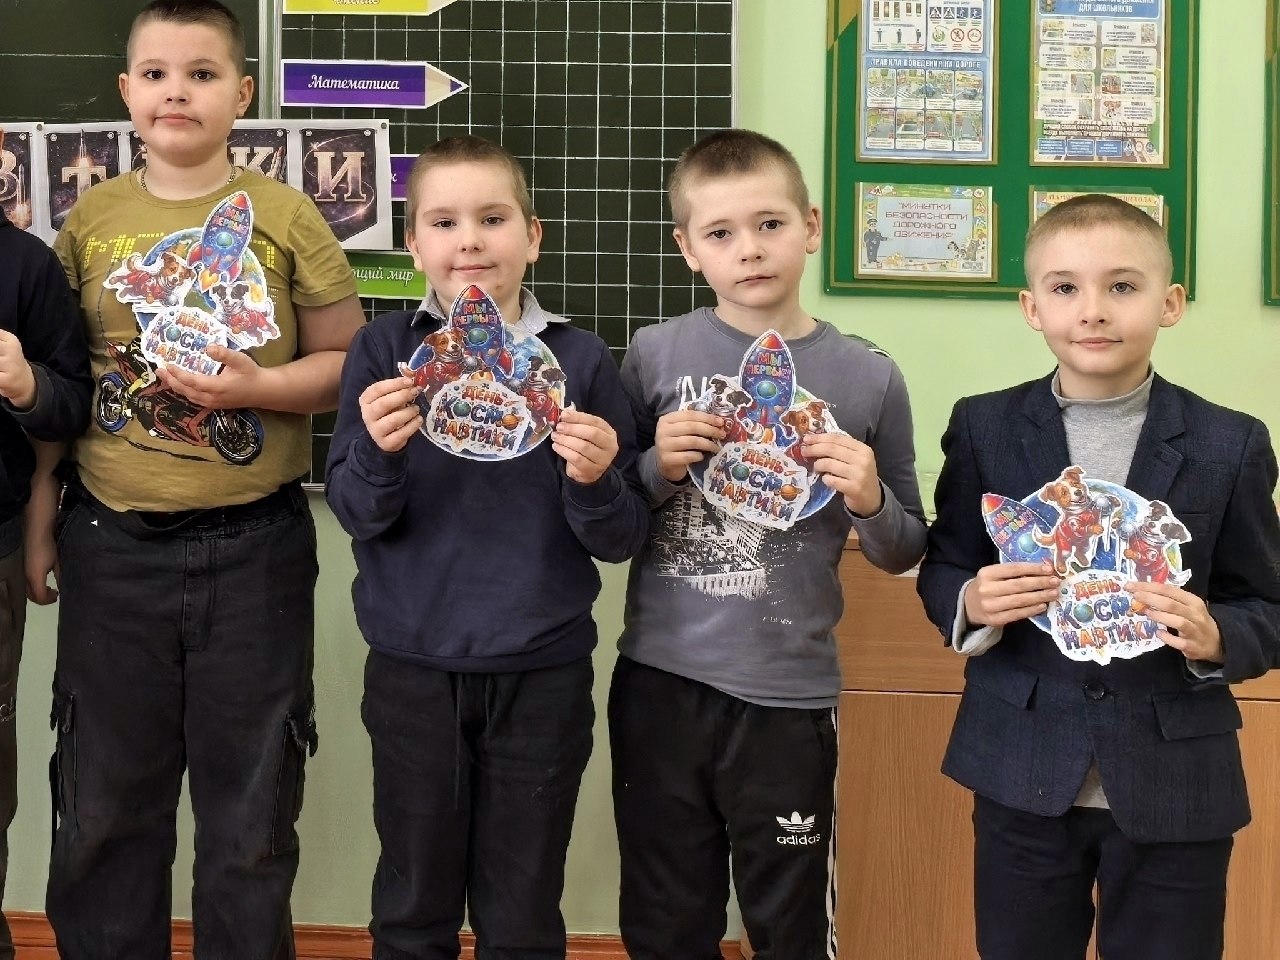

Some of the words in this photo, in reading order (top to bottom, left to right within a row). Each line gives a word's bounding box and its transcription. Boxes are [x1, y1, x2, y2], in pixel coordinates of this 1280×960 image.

[308, 74, 400, 90] Математика
[387, 269, 414, 286] мир
[463, 302, 487, 314] МЫ
[175, 313, 211, 334] ДЕНЬ
[153, 320, 208, 352] КОСМ
[757, 351, 782, 365] МЫ
[462, 385, 504, 405] ДЕНЬ
[742, 449, 785, 474] ДЕНЬ
[1073, 578, 1121, 601] ДЕНЬ
[777, 833, 821, 846] adidas
